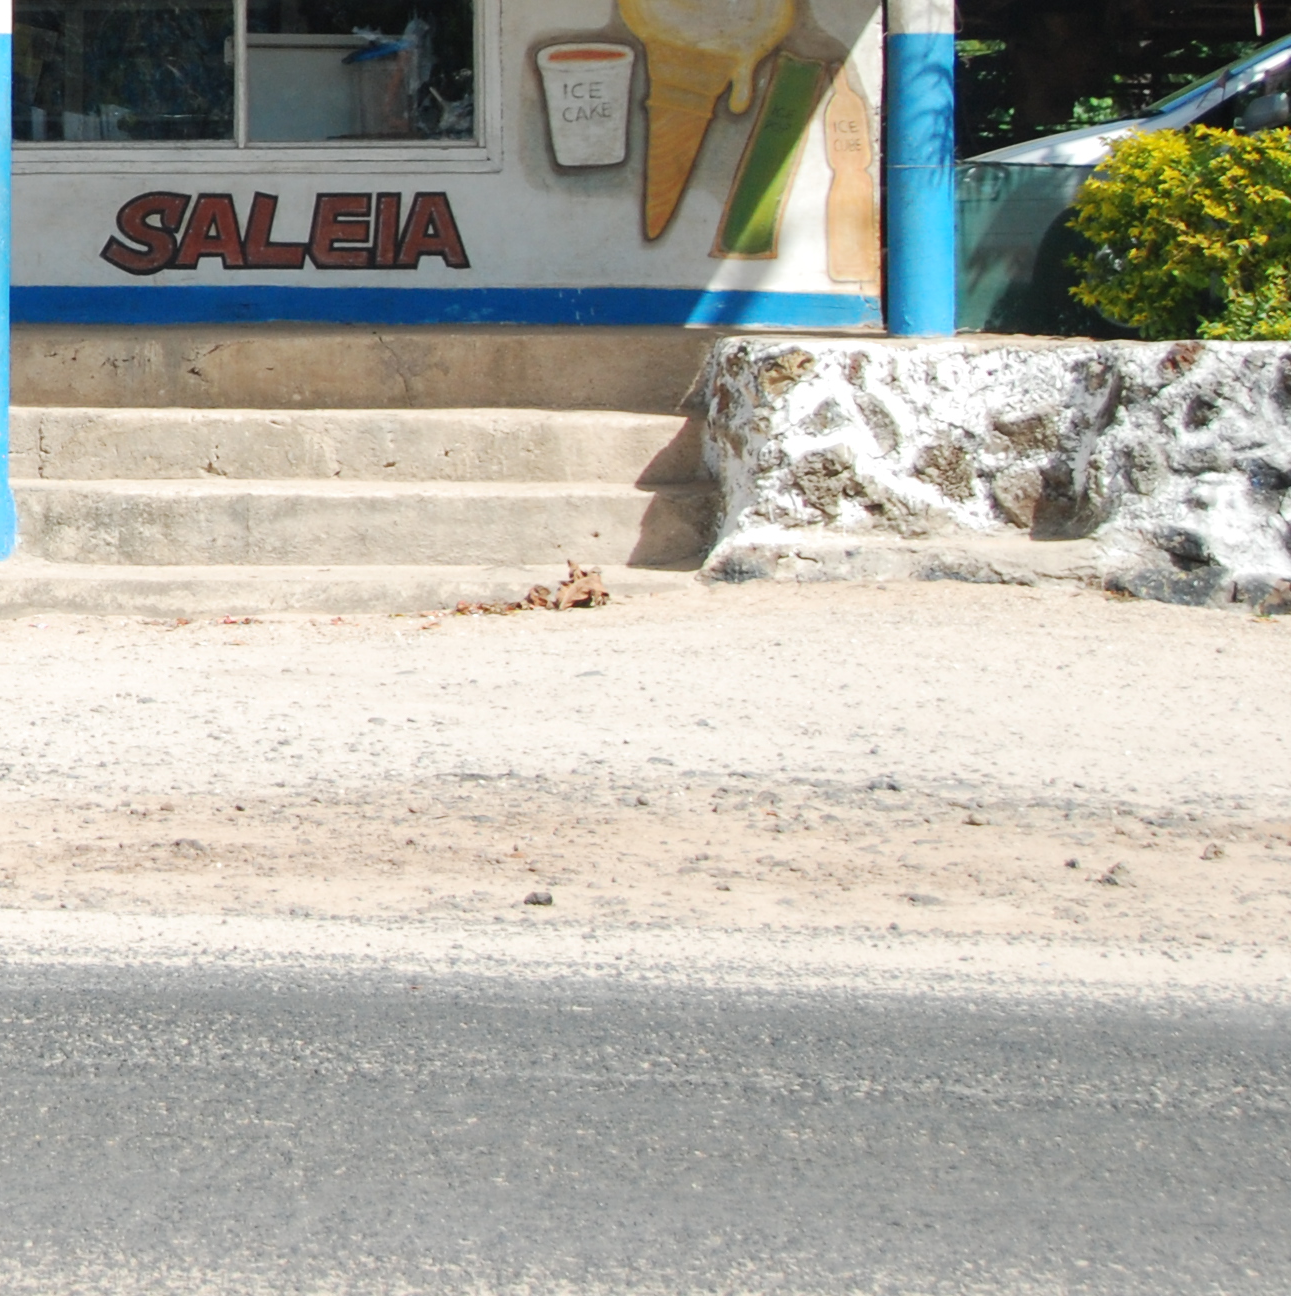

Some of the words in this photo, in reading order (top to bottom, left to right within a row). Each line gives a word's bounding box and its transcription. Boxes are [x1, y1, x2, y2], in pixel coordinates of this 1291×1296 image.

[562, 82, 604, 100] ICE
[561, 102, 613, 123] CAKE
[833, 120, 860, 134] ICE
[99, 190, 471, 276] SALEIA
